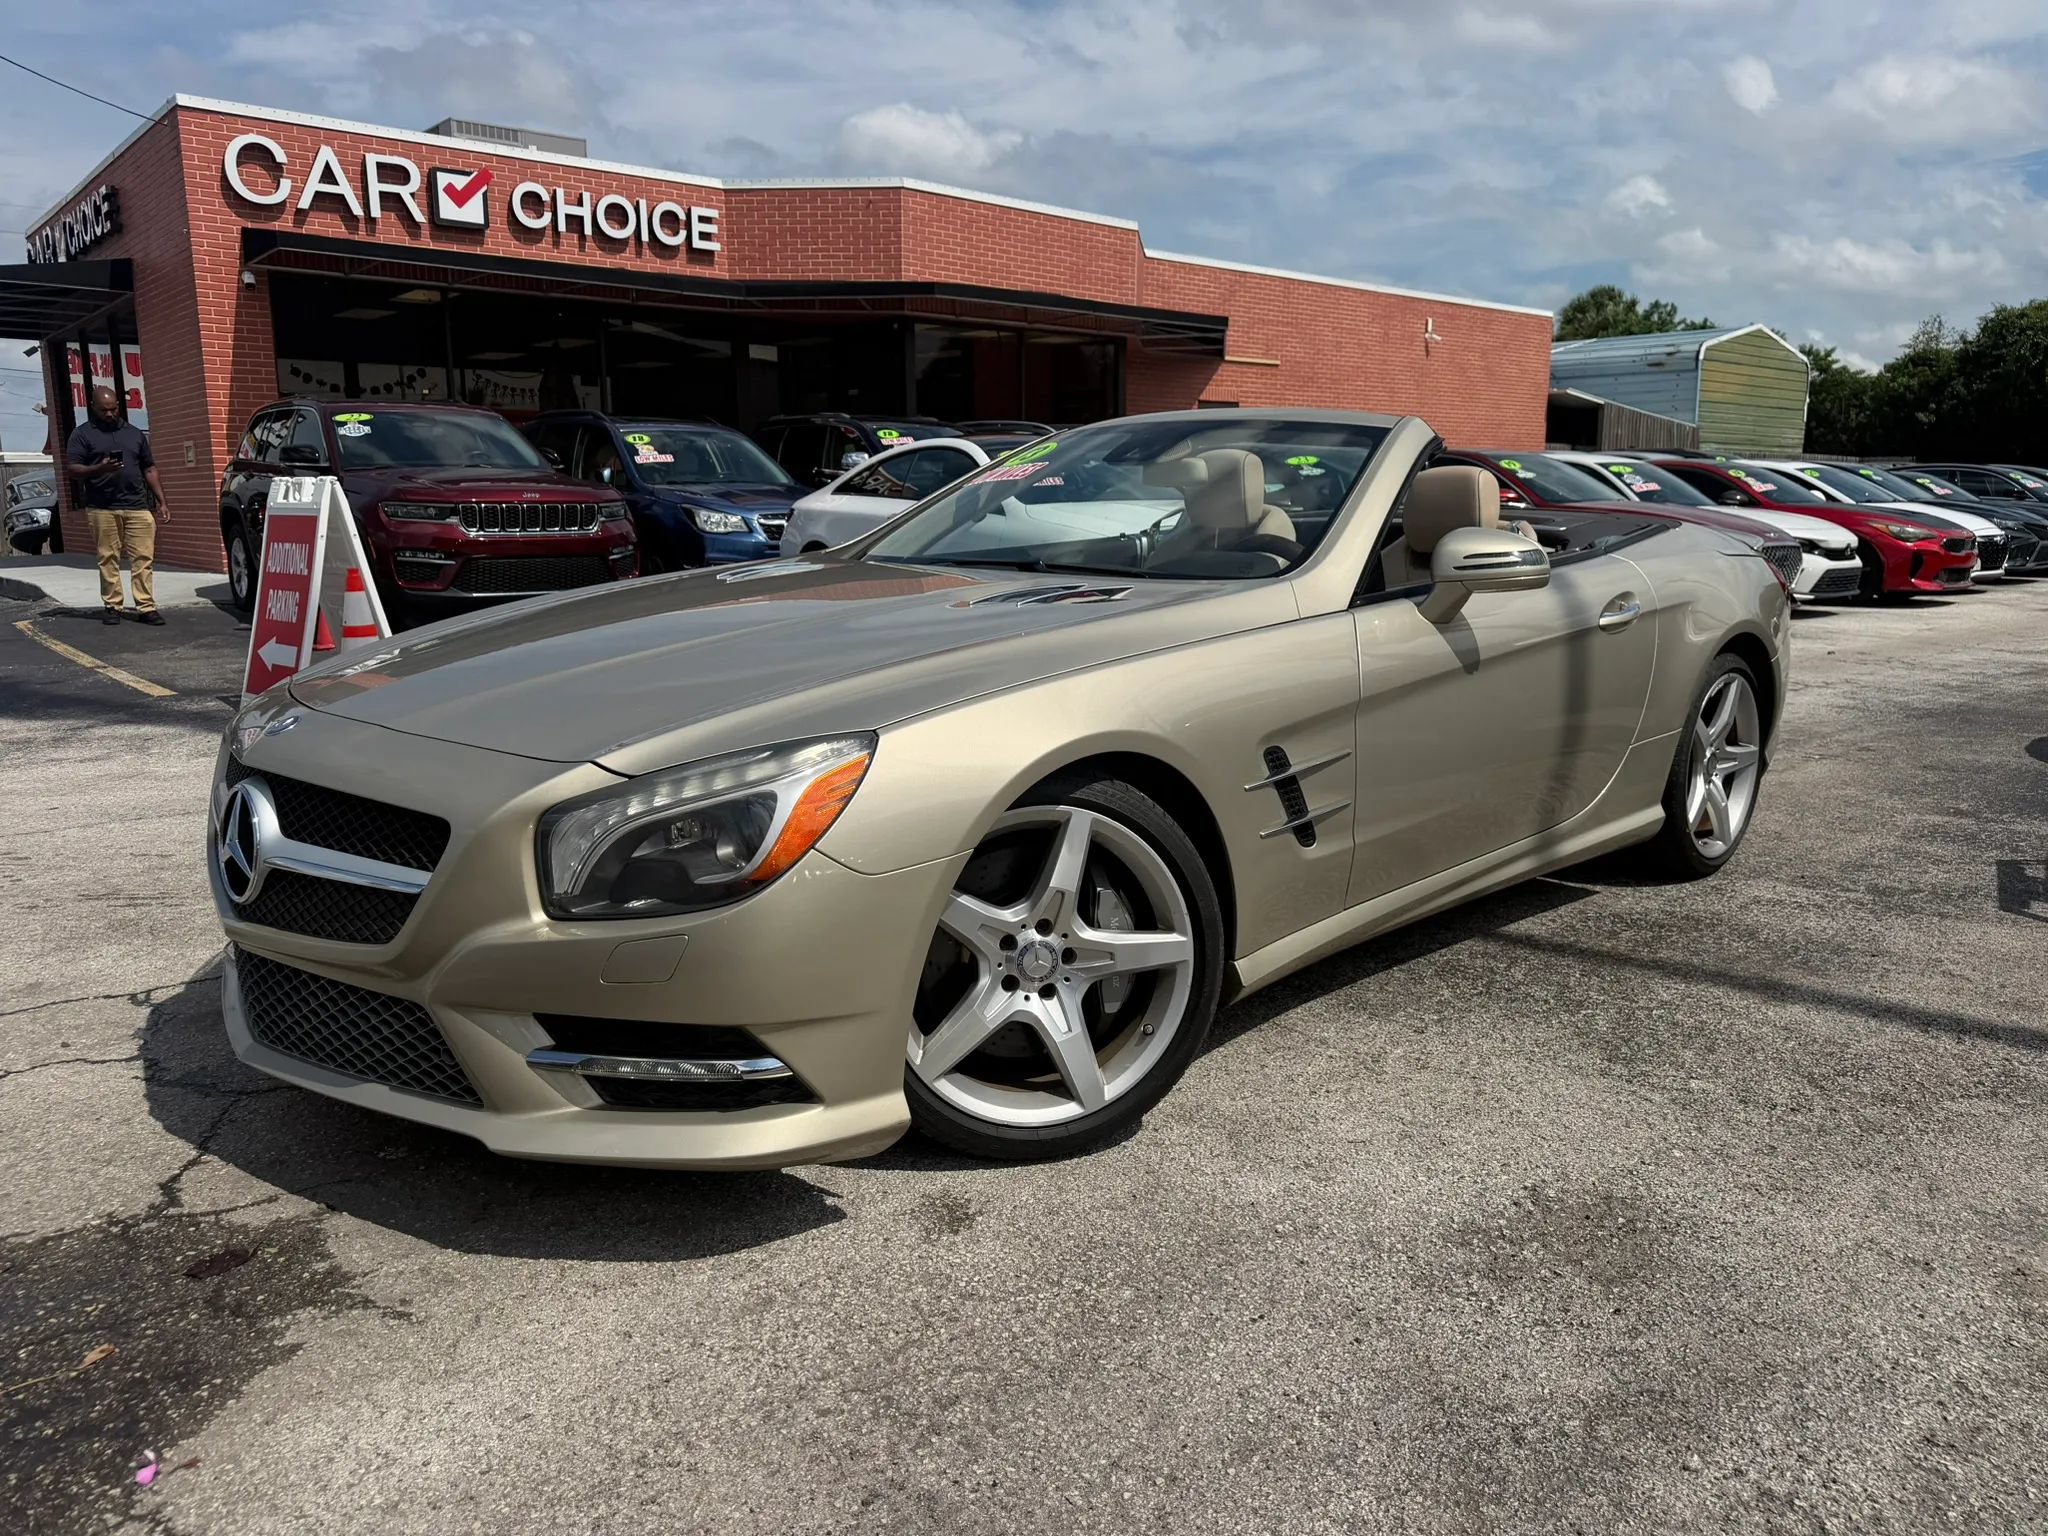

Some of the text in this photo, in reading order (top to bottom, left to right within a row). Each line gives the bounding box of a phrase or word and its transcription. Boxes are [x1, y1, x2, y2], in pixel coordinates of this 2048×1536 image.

[224, 133, 722, 252] CAR CHOICE
[66, 184, 111, 255] CHOICE
[521, 491, 540, 499] Jeep
[266, 542, 309, 576] ADDITIONAL
[265, 589, 300, 623] PARKING
